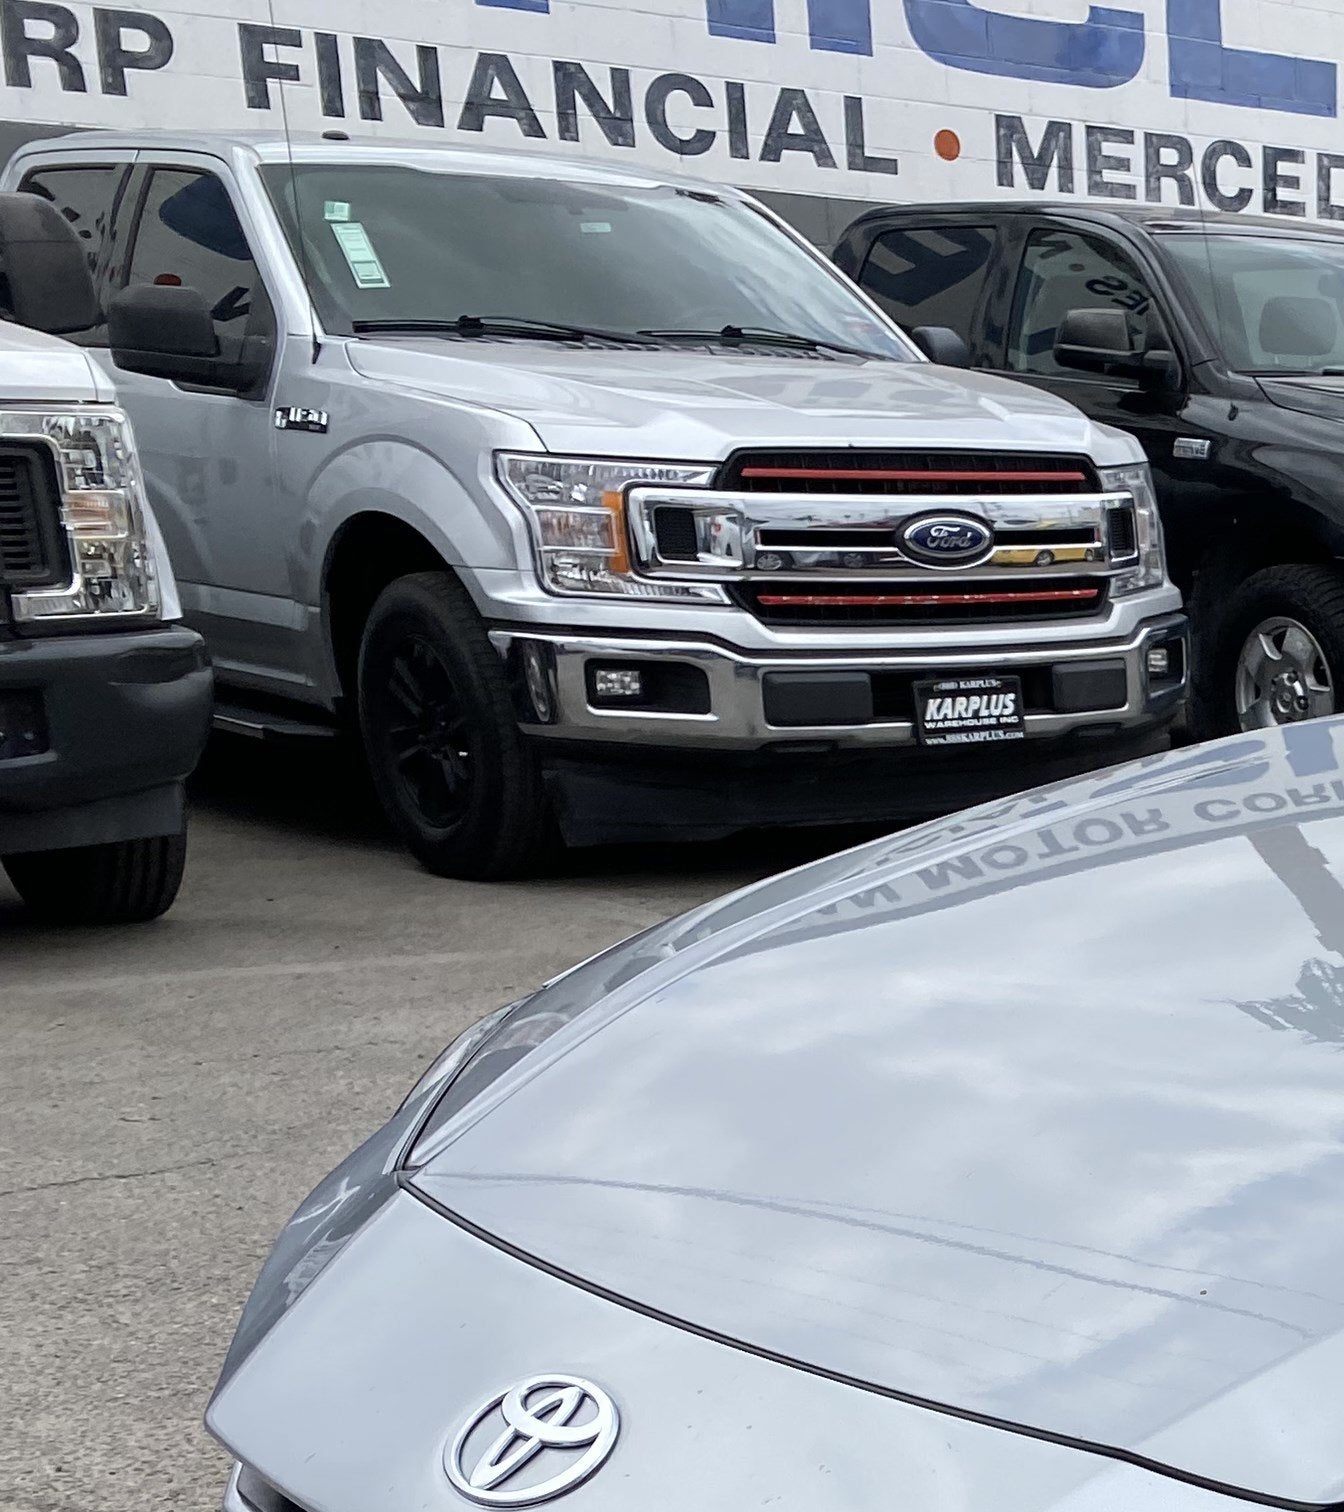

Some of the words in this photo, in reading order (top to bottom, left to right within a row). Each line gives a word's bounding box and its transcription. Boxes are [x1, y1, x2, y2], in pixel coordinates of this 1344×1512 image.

[237, 22, 899, 175] FINANCIAL
[926, 525, 973, 549] Ford
[925, 693, 1017, 720] KARPLUS
[924, 717, 997, 729] WAREHOUSE
